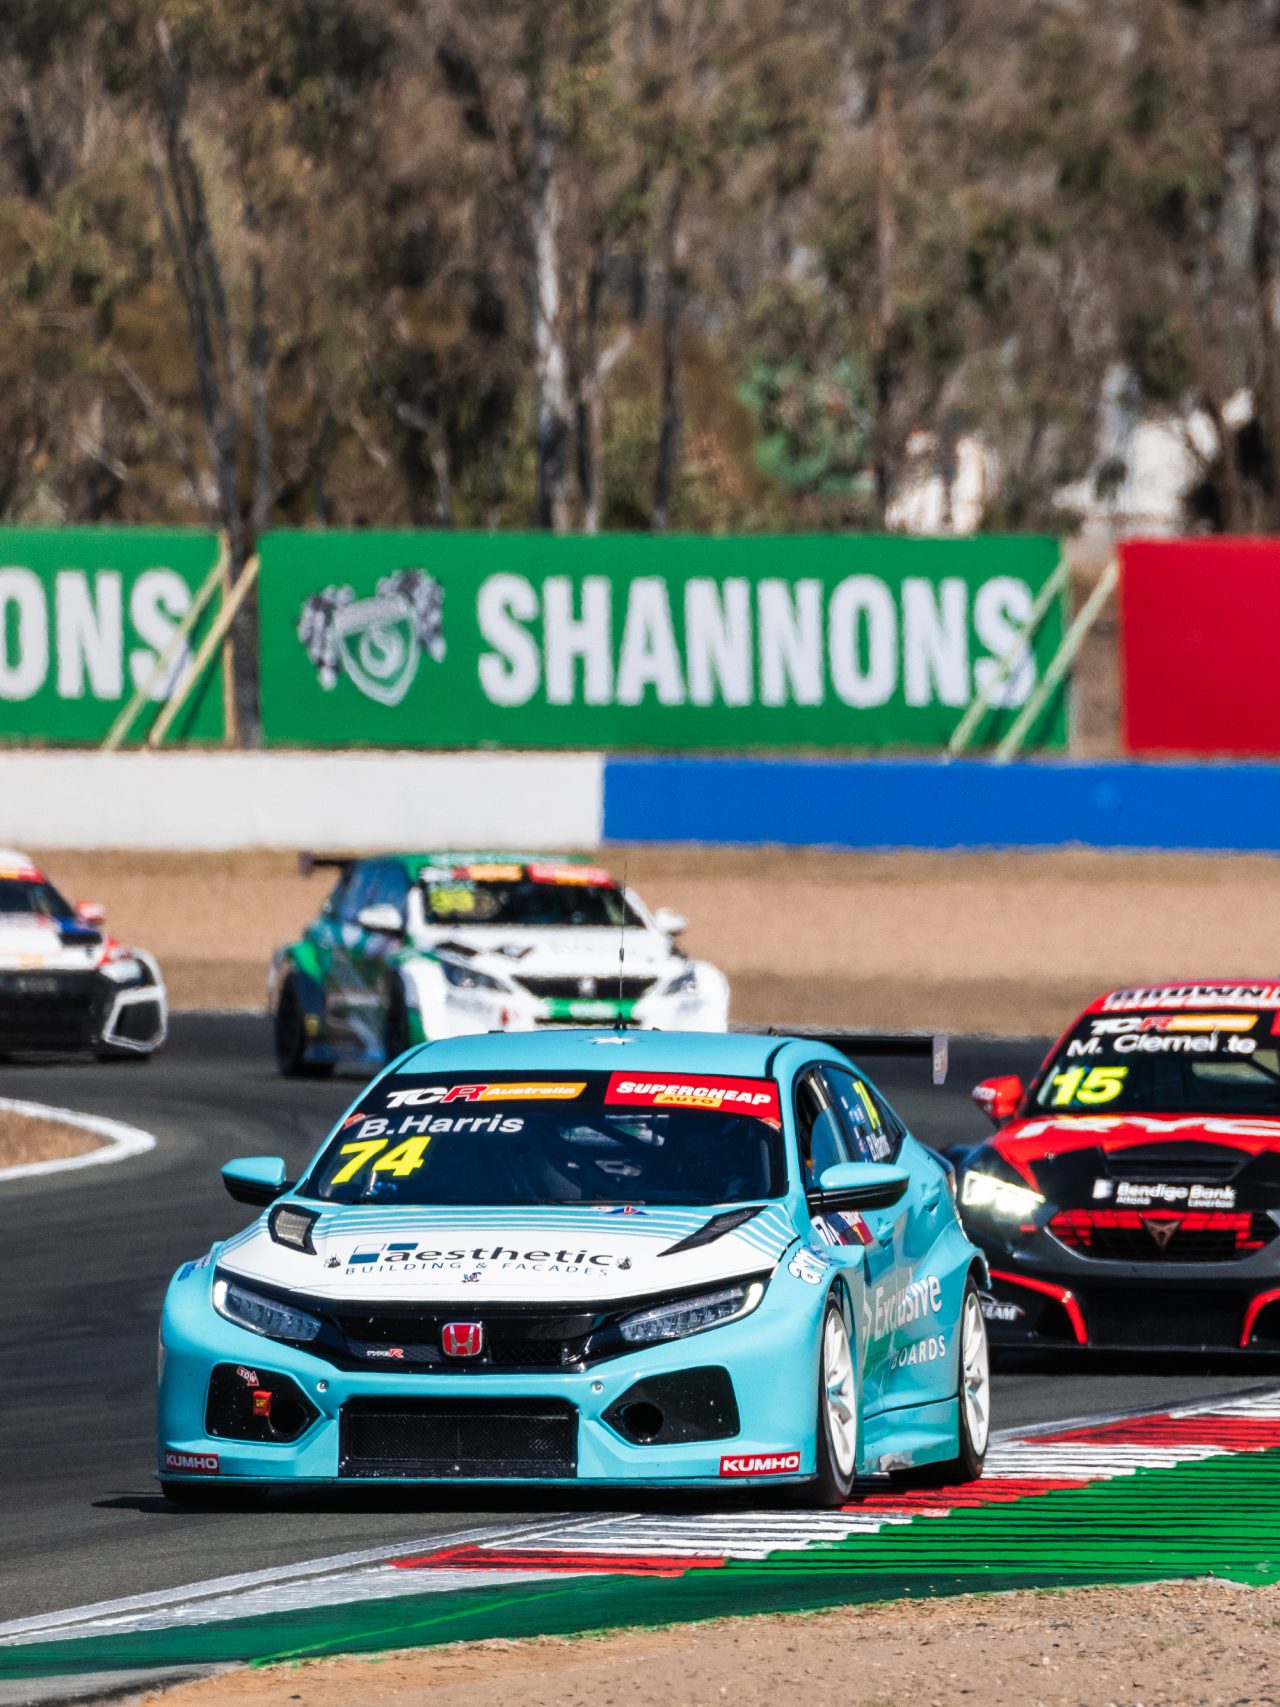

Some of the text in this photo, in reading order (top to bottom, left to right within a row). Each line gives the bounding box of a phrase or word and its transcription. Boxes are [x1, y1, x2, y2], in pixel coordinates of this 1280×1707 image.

[476, 571, 1037, 708] SHANNONS
[386, 1084, 578, 1109] TCR Australia
[616, 1081, 771, 1105] SUPERCHEAP
[1053, 1066, 1128, 1105] 15
[661, 1096, 714, 1105] AUTO
[357, 1114, 524, 1139] B.Harris
[331, 1135, 431, 1184] 74
[1190, 1184, 1236, 1200] Bank
[384, 1246, 614, 1267] aesthetic
[345, 1261, 609, 1277] BUILDING & FACADES
[166, 1454, 218, 1469] KUMHO
[723, 1455, 799, 1472] KUMHO
